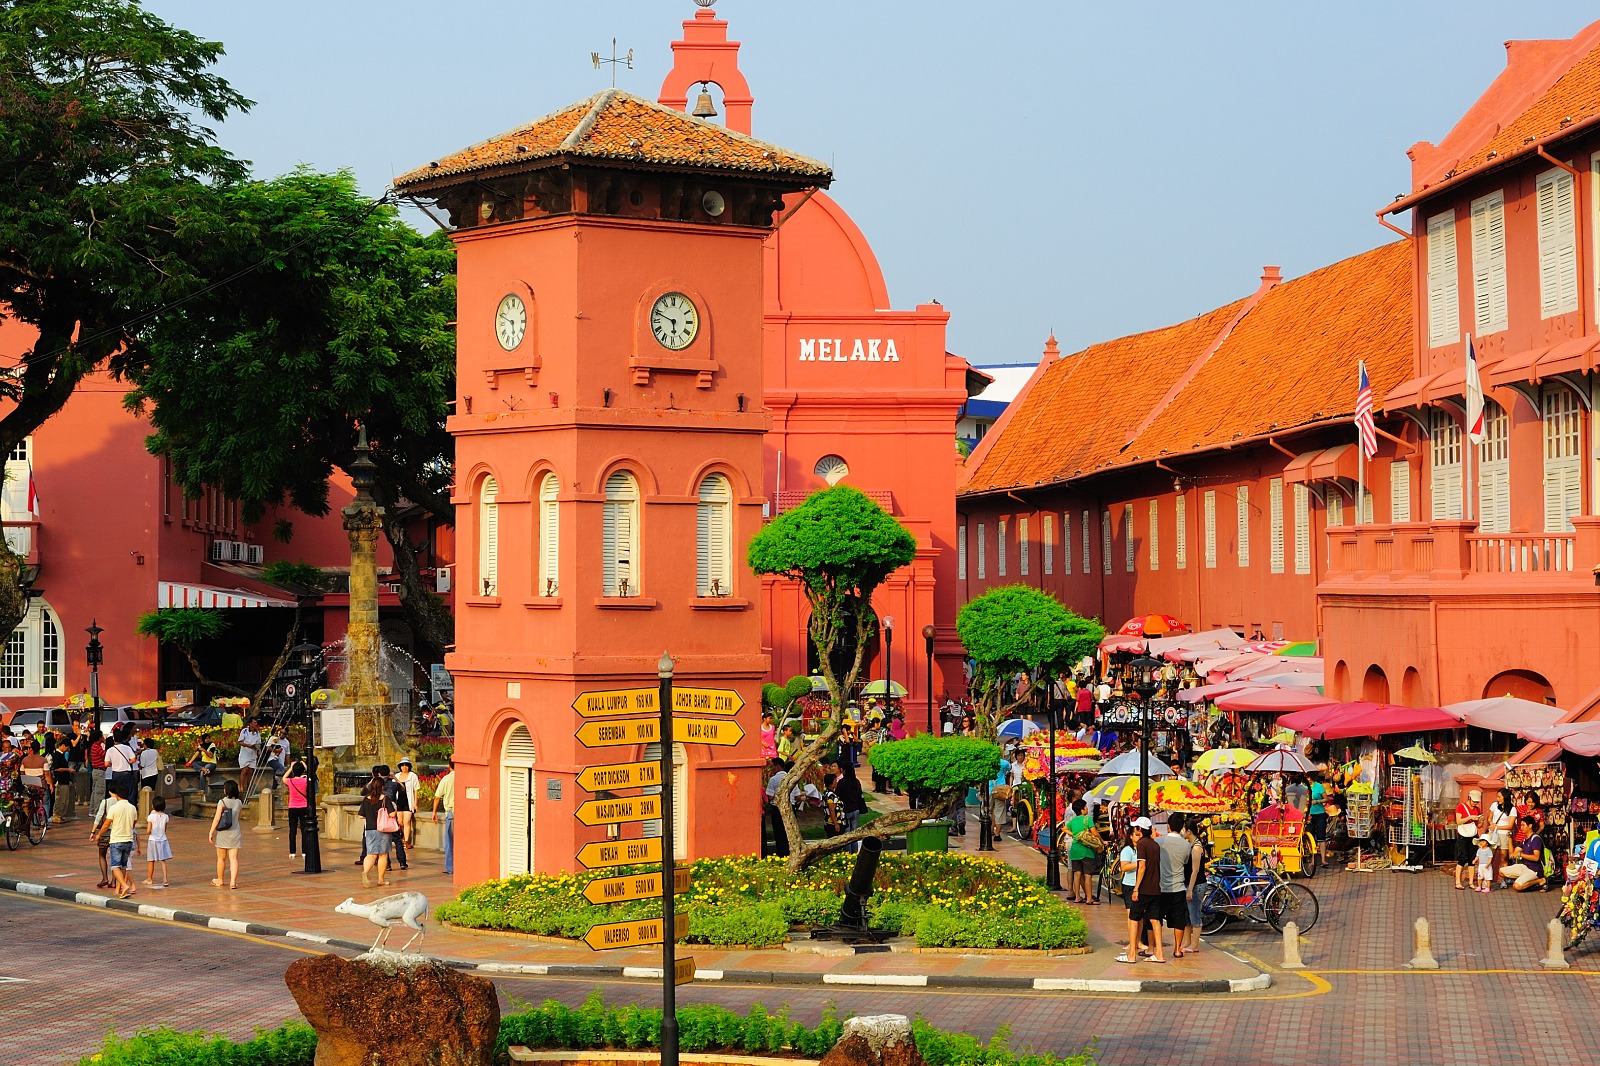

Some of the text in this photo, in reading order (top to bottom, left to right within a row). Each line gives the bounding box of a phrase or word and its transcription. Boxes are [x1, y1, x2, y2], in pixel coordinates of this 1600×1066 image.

[799, 338, 900, 362] MELAKA
[587, 696, 605, 712] KUALA
[606, 695, 628, 711] LUMPUR
[645, 693, 654, 707] KM
[675, 693, 693, 708] JOHOR
[694, 694, 711, 710] BAHRU
[724, 696, 733, 711] KM
[598, 725, 626, 741] SEREMBAN
[646, 724, 654, 738] KM
[687, 723, 702, 738] MUAR
[709, 724, 718, 739] KM
[593, 771, 607, 786] PORT
[608, 769, 630, 785] DICKSON
[646, 766, 655, 780] KM
[596, 803, 614, 819] MASJID
[615, 801, 633, 817] TANAH
[600, 846, 619, 862] MEKAH
[639, 843, 649, 858] KM
[603, 881, 625, 897] NANJING
[646, 878, 655, 893] KM
[603, 927, 630, 944] VALPERISO
[650, 924, 658, 939] KM
